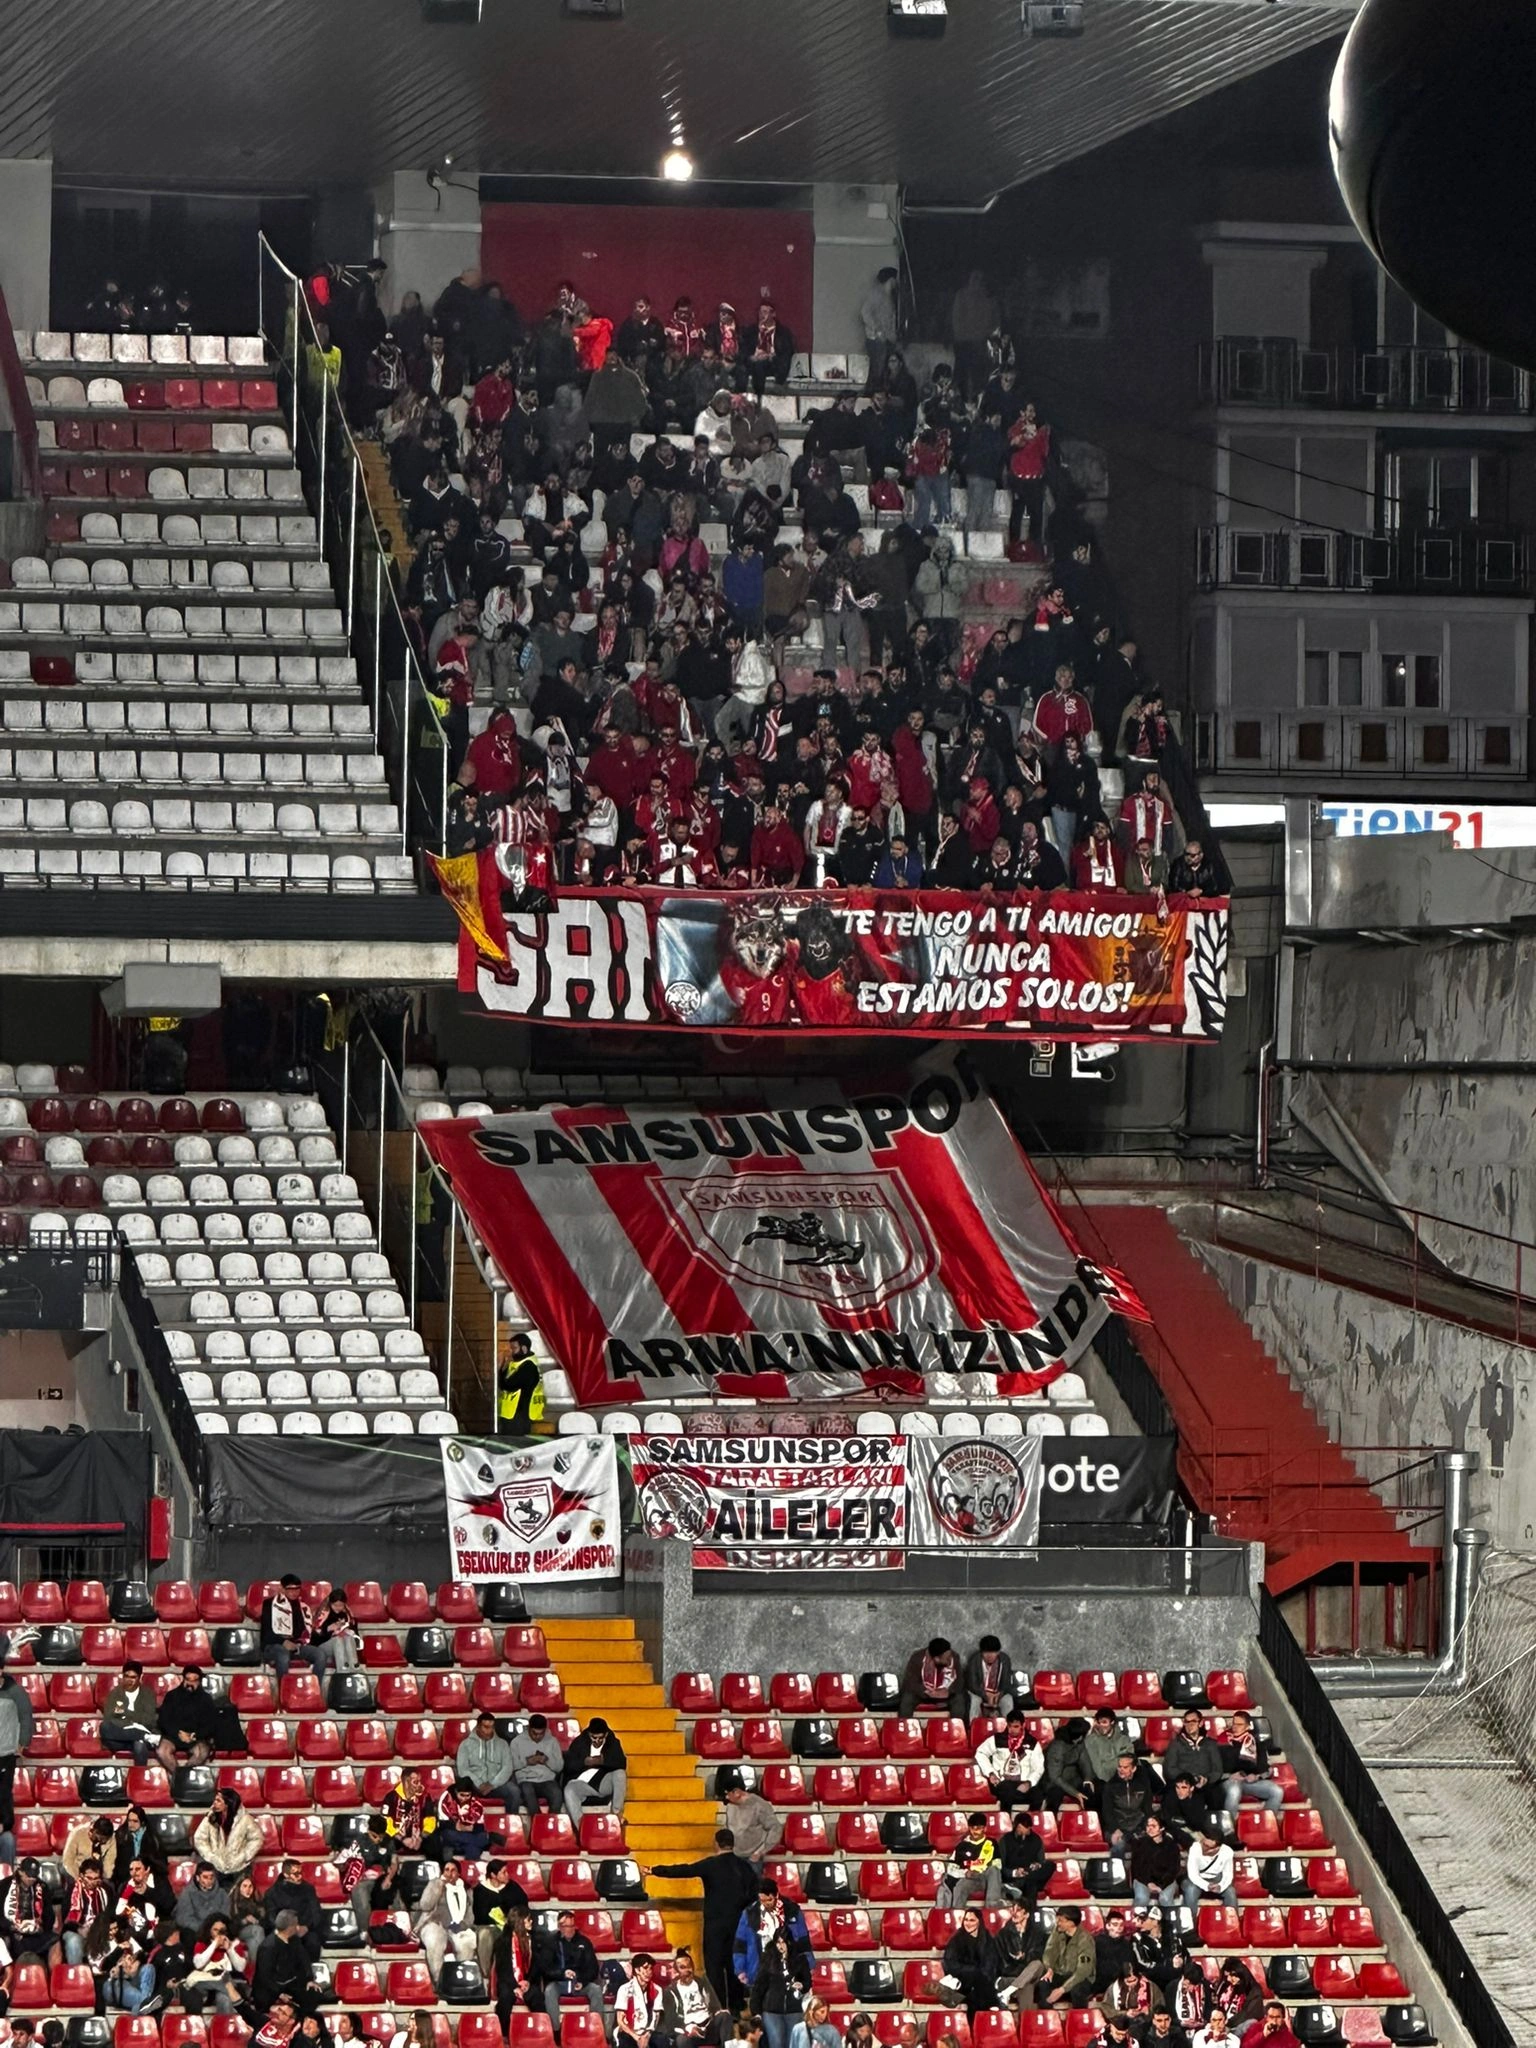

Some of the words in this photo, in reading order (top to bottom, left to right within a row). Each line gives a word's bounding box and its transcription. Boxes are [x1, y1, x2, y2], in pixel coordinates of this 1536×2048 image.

[842, 909, 876, 934] TE
[882, 910, 972, 936] TENGO
[979, 907, 996, 932] A
[936, 941, 1051, 977] NUNCA
[857, 978, 1012, 1013] ESTAMOS
[1018, 977, 1135, 1013] SOLOS!
[694, 1188, 876, 1207] SAMSUNSPOR
[649, 1437, 892, 1464] SAMSUNSPOR
[704, 1467, 894, 1487] TARAFTARLARI
[1040, 1456, 1120, 1493] ote
